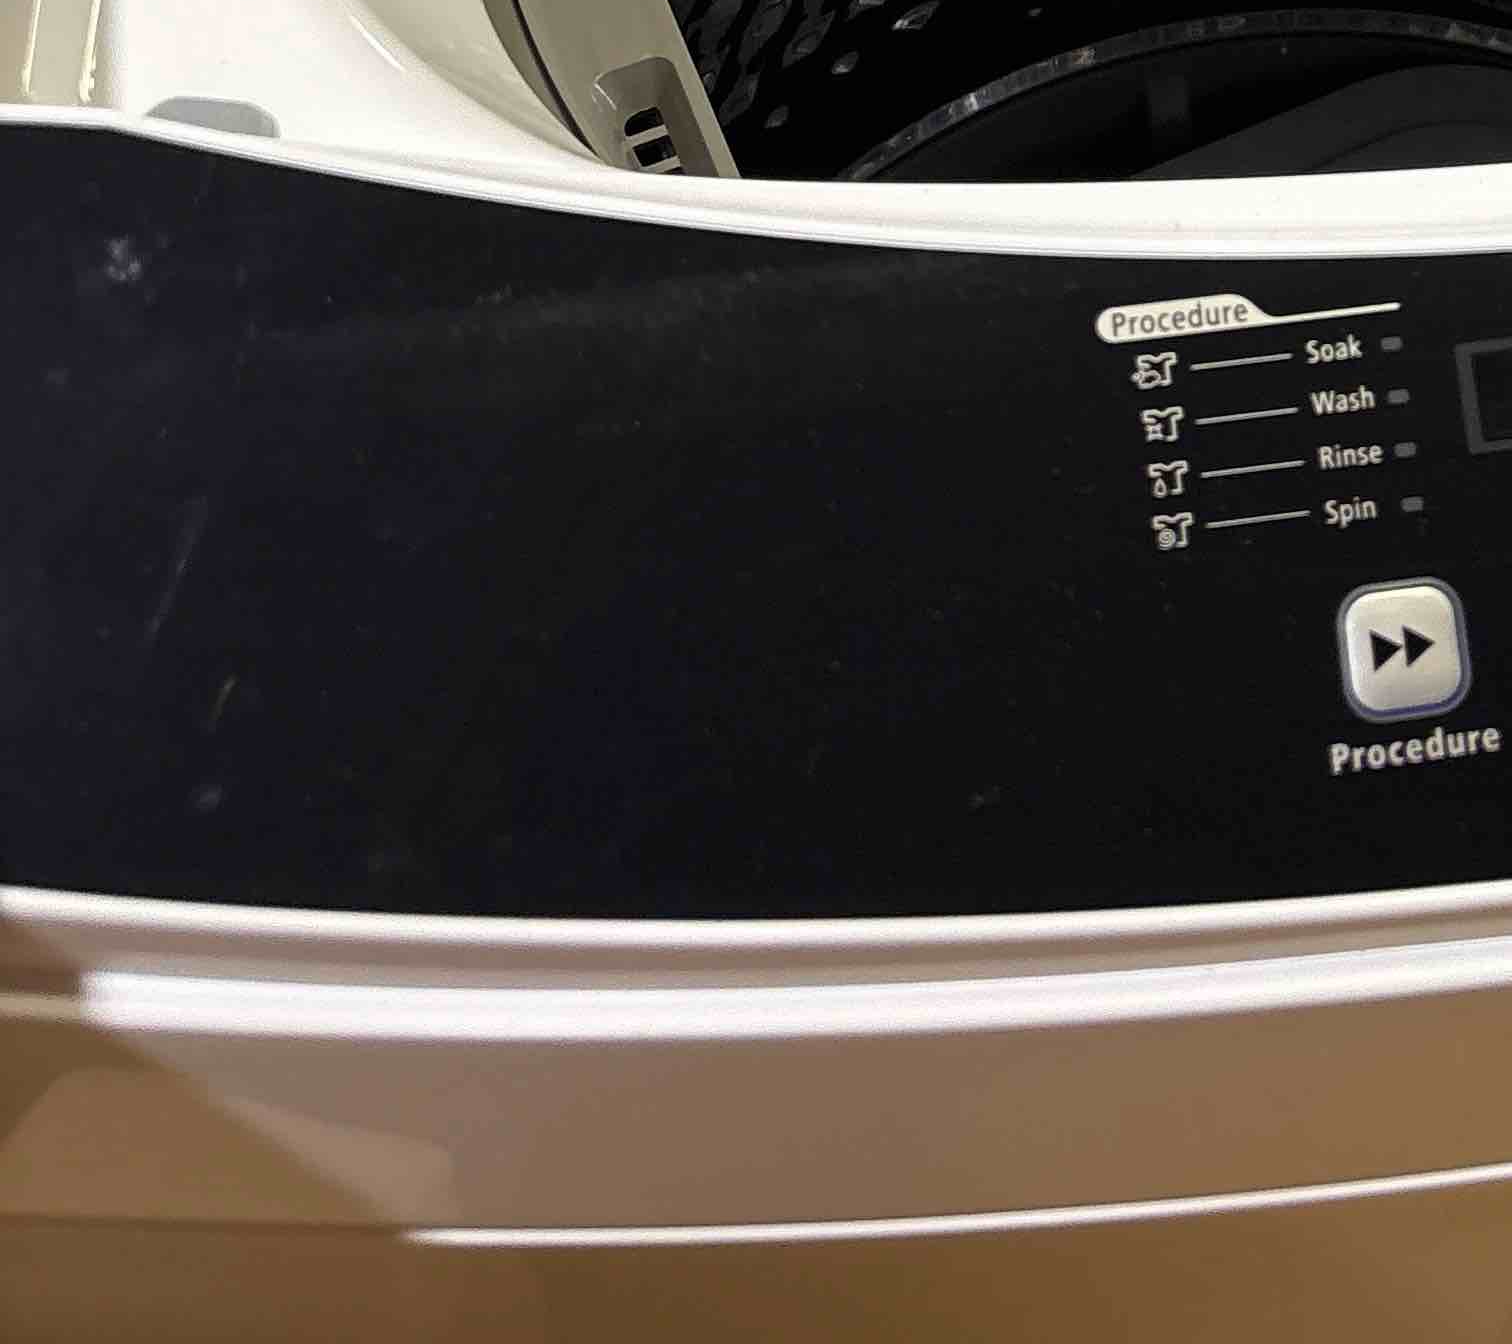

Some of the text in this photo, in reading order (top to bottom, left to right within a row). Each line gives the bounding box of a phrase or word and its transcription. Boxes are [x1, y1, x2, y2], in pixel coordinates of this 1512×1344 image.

[1111, 300, 1249, 338] Procedure
[1305, 334, 1363, 364] Soak
[1310, 384, 1375, 415] Wash
[1317, 444, 1383, 469] Rinse
[1324, 495, 1377, 528] Spin
[1330, 726, 1501, 776] Procedure
